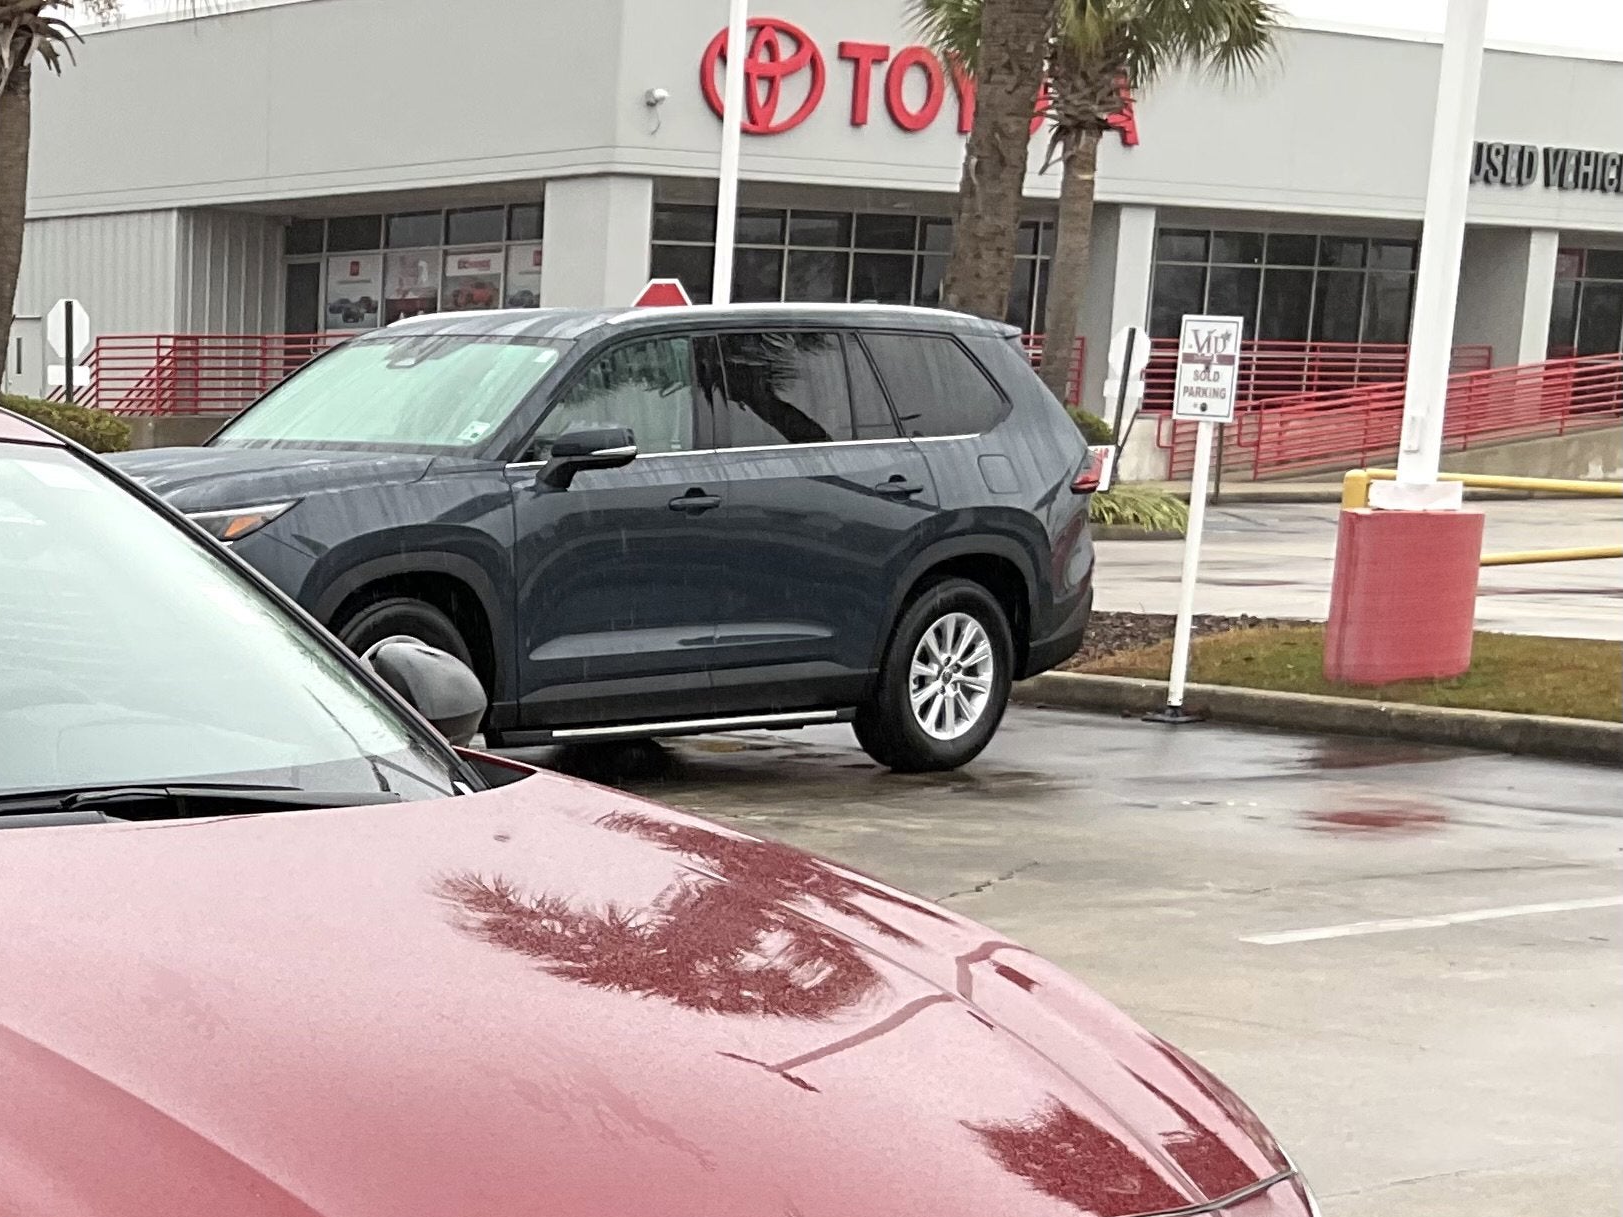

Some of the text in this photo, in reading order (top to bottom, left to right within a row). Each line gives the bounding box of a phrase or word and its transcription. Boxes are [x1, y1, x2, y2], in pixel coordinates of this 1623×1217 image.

[838, 41, 1139, 146] TOYA
[1470, 141, 1623, 194] USED VEHIC
[1193, 369, 1220, 382] SOLD
[1183, 386, 1227, 399] PARKING
